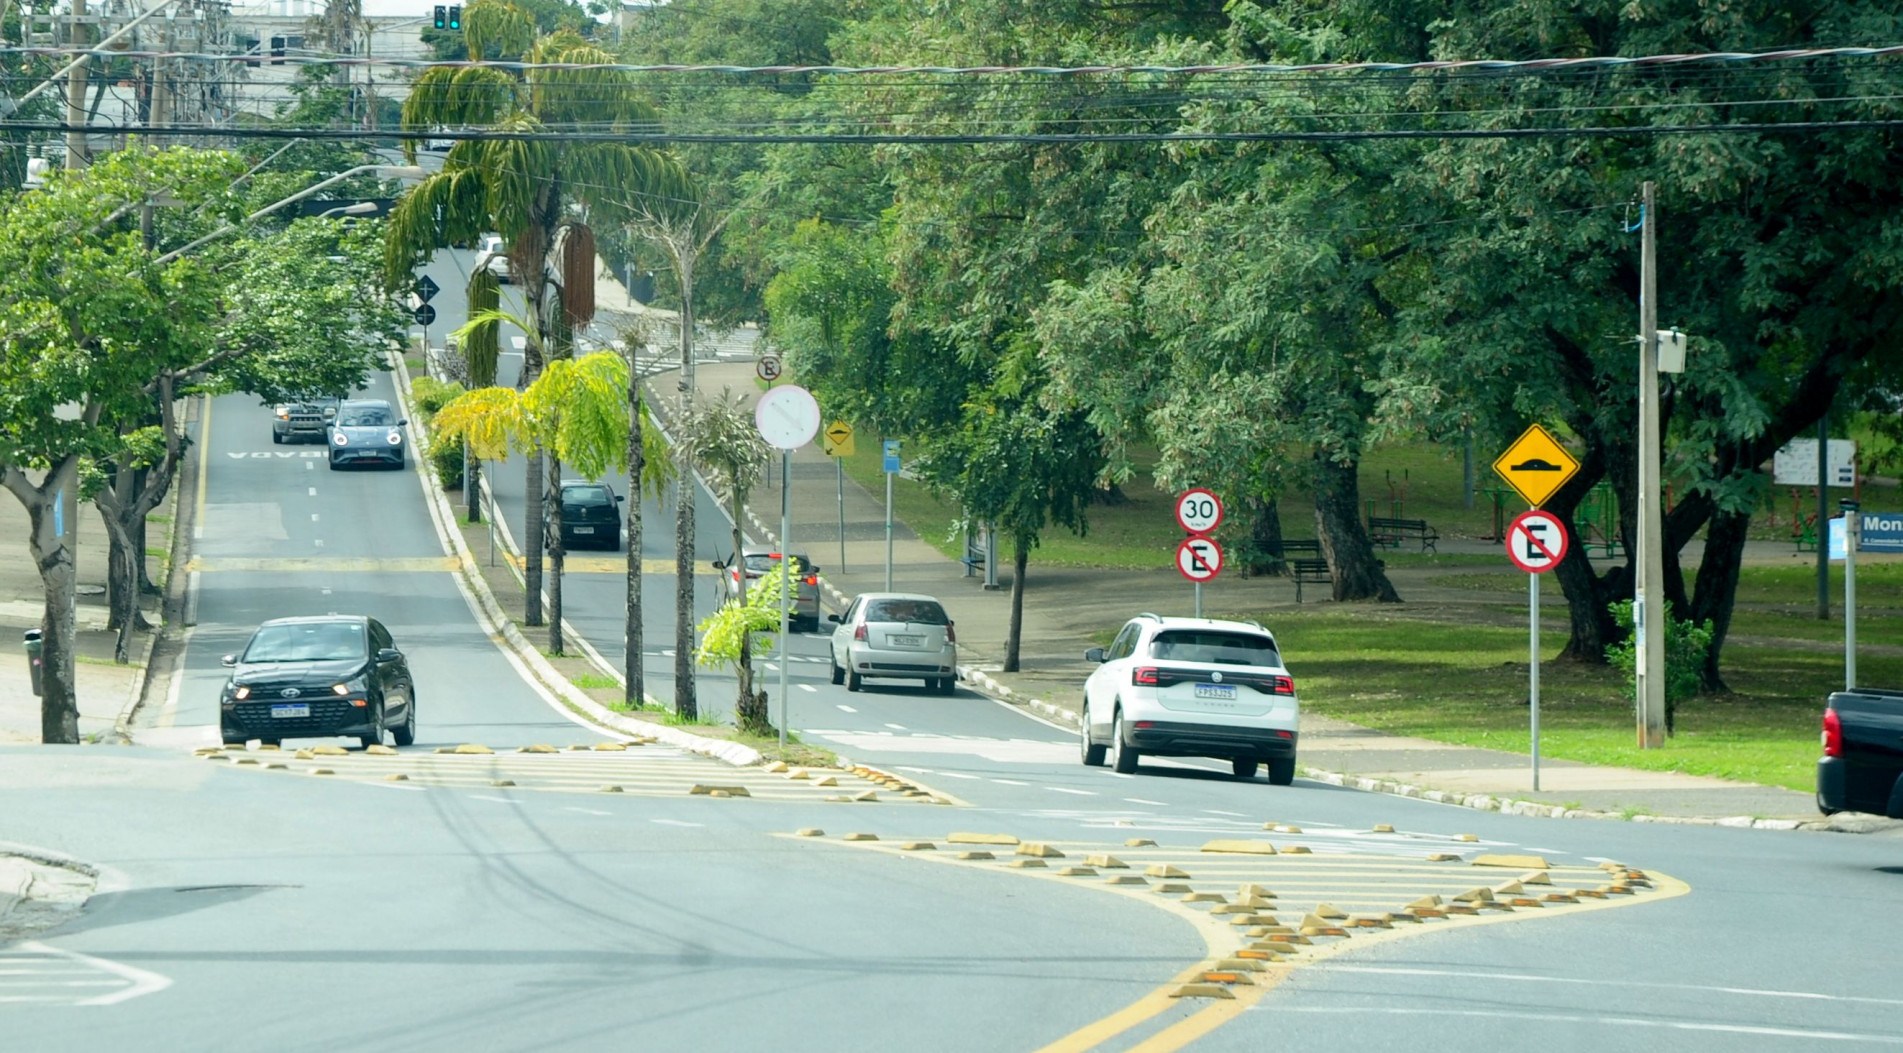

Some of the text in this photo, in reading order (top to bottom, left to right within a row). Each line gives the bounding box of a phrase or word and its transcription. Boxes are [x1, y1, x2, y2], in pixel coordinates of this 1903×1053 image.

[1185, 500, 1213, 518] 30
[1864, 516, 1903, 531] Mon
[1527, 525, 1547, 558] E
[1192, 546, 1207, 571] E
